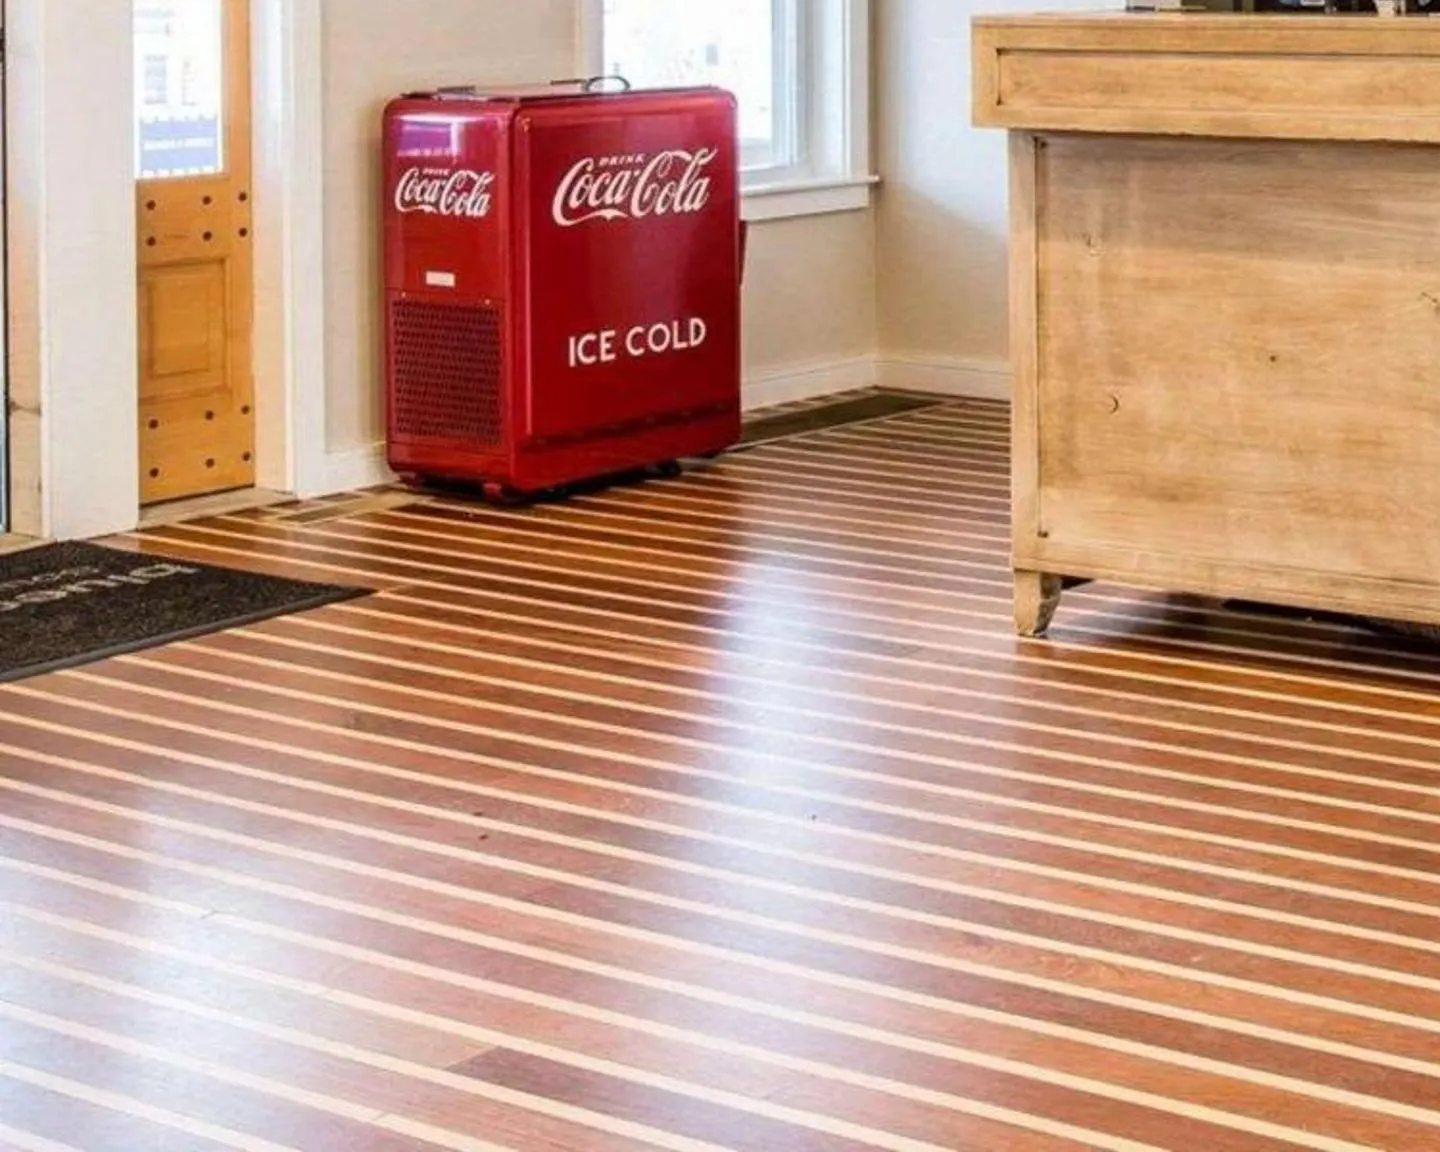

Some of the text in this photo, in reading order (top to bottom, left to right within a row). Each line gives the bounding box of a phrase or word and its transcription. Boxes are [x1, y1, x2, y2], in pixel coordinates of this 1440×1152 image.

[599, 152, 645, 167] DRINK
[394, 166, 494, 218] Coca-Cola
[552, 148, 718, 227] Coca-Cola
[568, 317, 706, 368] ICE COLD
